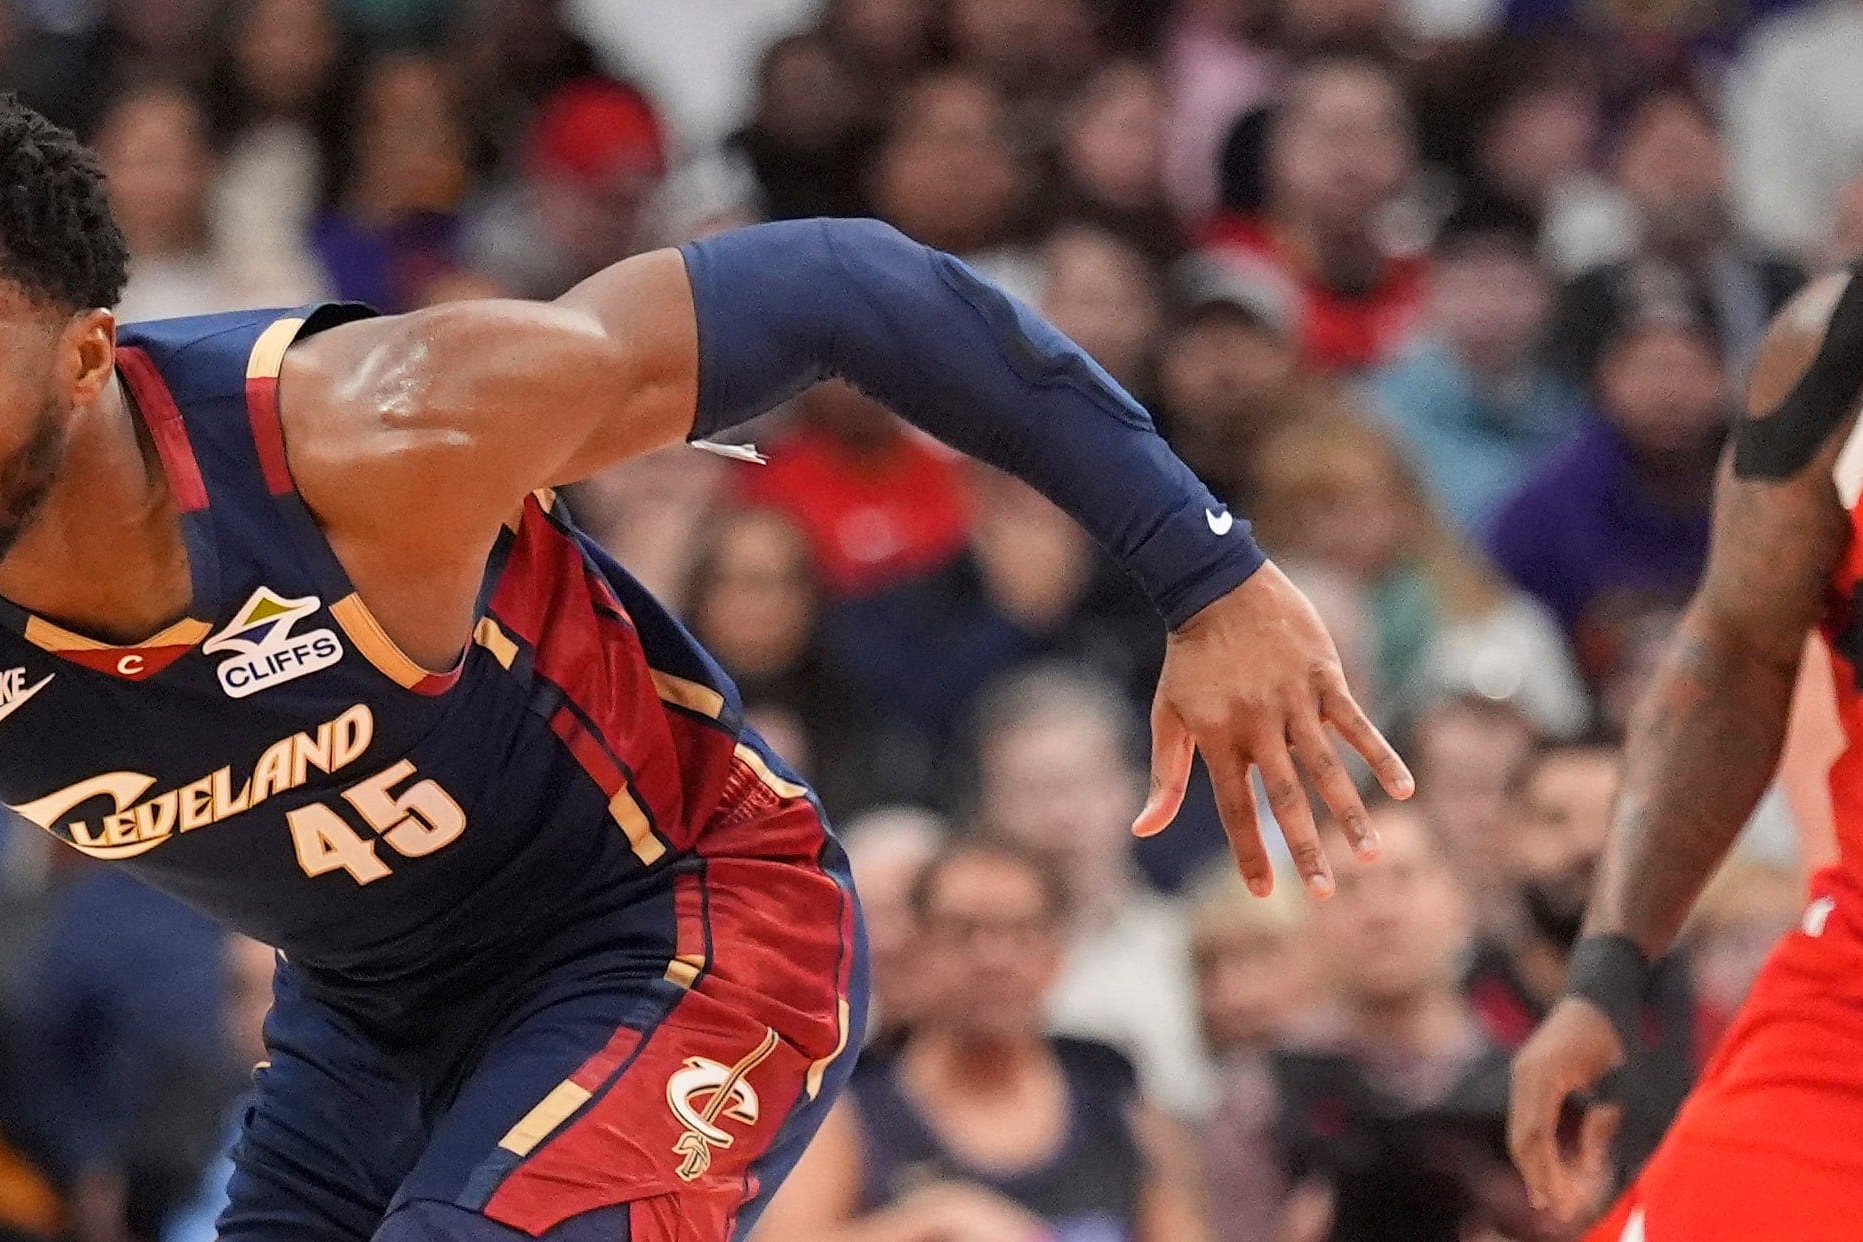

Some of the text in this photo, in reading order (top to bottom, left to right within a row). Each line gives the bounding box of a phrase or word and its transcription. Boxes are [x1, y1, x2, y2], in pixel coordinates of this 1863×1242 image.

[225, 637, 337, 688] CLIFFS
[7, 703, 374, 860] CLEVELAND
[285, 758, 467, 886] 45
